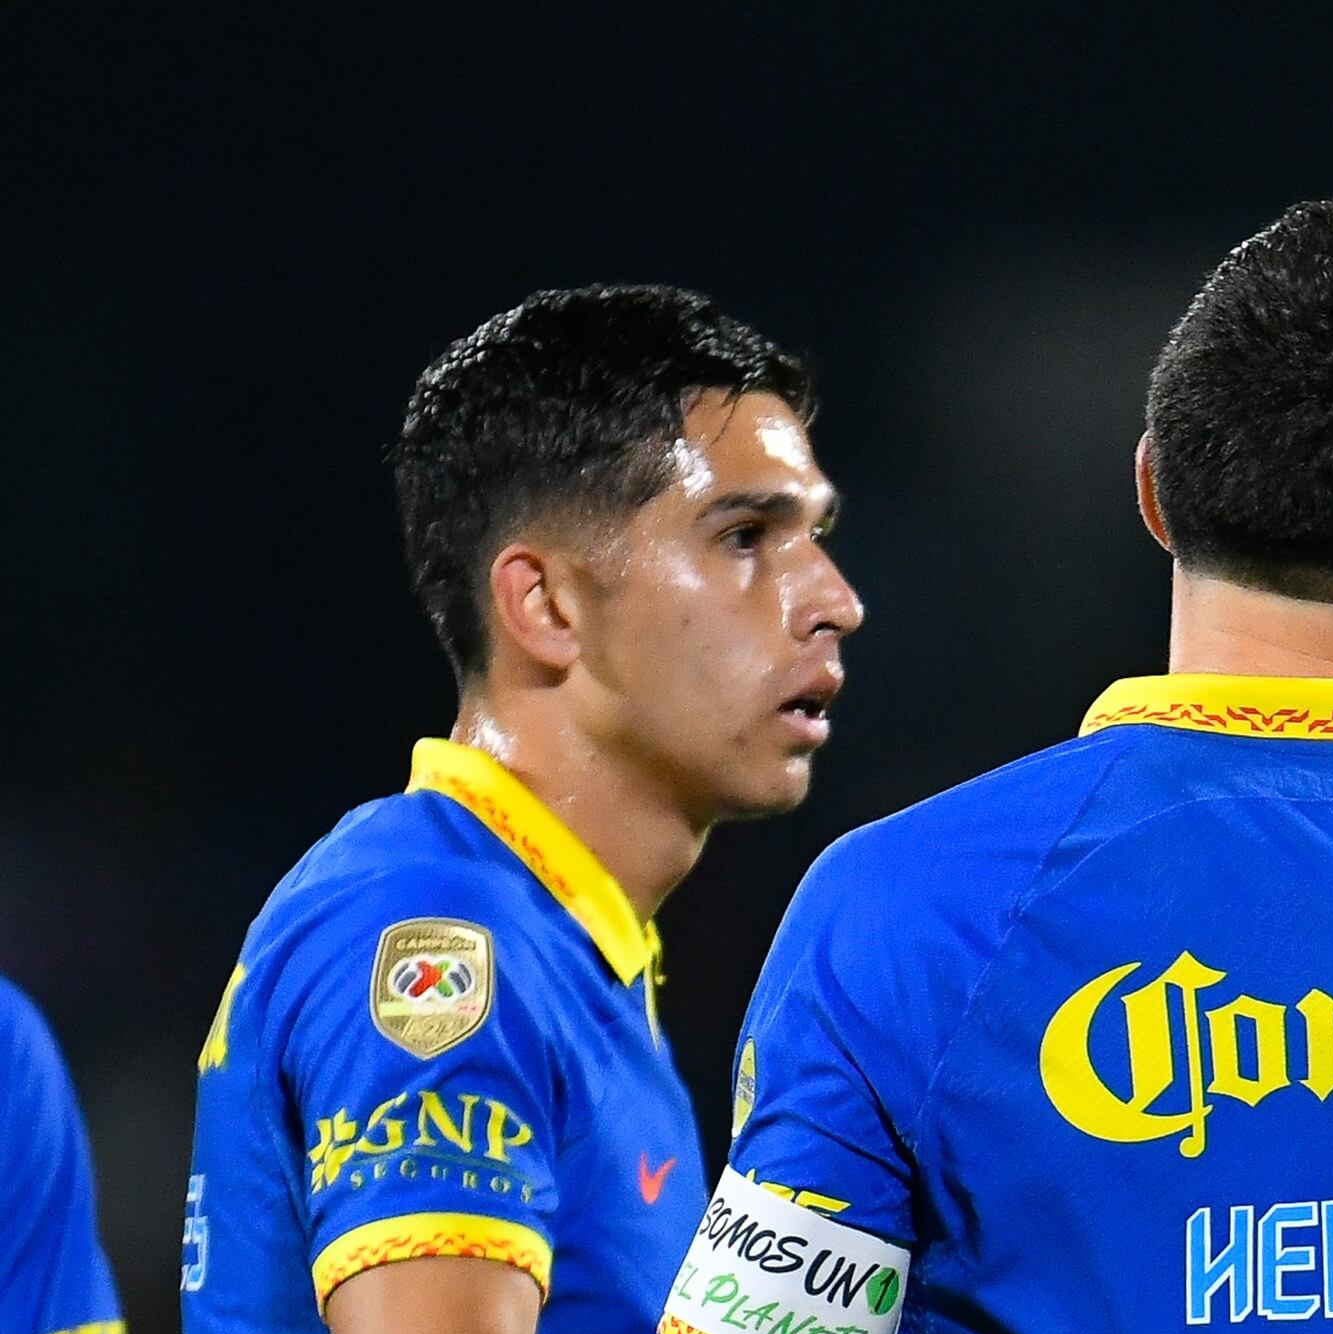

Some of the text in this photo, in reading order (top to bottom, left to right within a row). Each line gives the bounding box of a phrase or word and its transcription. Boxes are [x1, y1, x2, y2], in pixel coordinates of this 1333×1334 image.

[353, 1091, 533, 1164] GNP
[350, 1158, 533, 1204] SEGUROS
[699, 1197, 809, 1274] SOMOS
